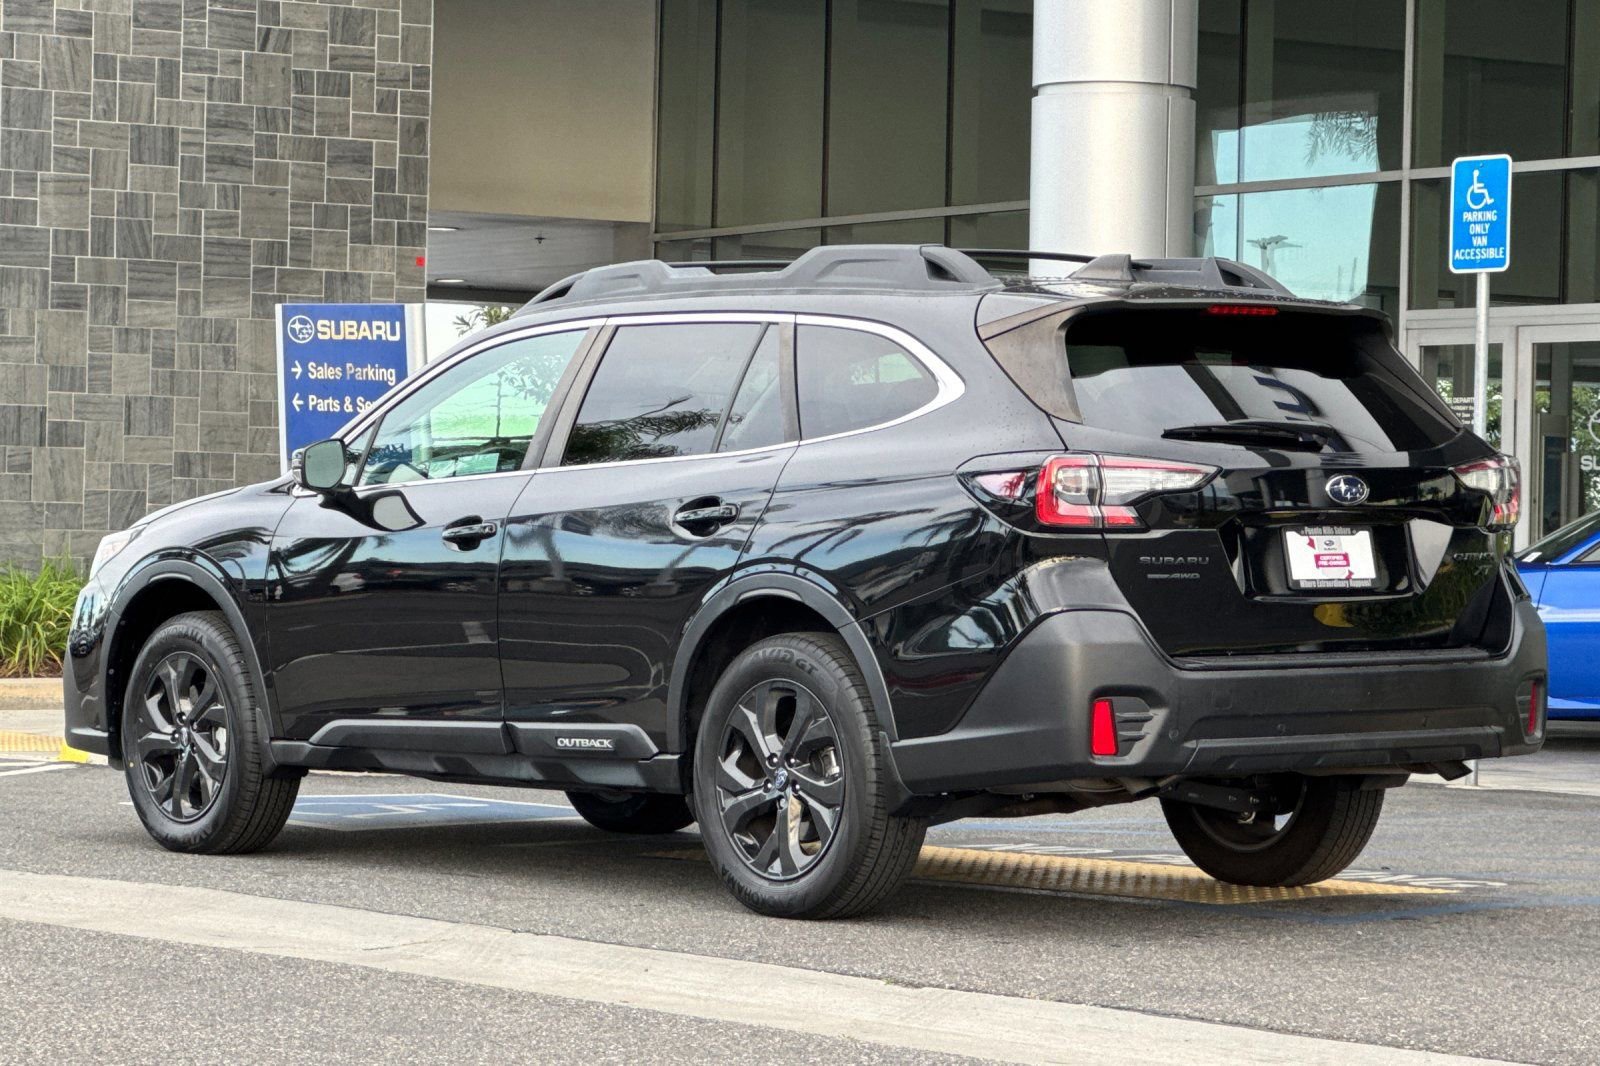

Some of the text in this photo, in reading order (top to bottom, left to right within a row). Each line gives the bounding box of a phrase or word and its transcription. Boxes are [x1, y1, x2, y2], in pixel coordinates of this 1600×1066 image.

[1463, 210, 1497, 222] PARKING
[1469, 223, 1490, 235] ONLY
[1471, 235, 1488, 247] VAN
[1454, 247, 1505, 261] ACCESSIBLE
[316, 319, 401, 341] SUBARU
[307, 361, 396, 386] Sales Parking
[308, 394, 341, 413] Parts
[343, 395, 354, 413] &
[1139, 556, 1210, 565] SUBARU
[556, 737, 613, 749] OUTBACK
